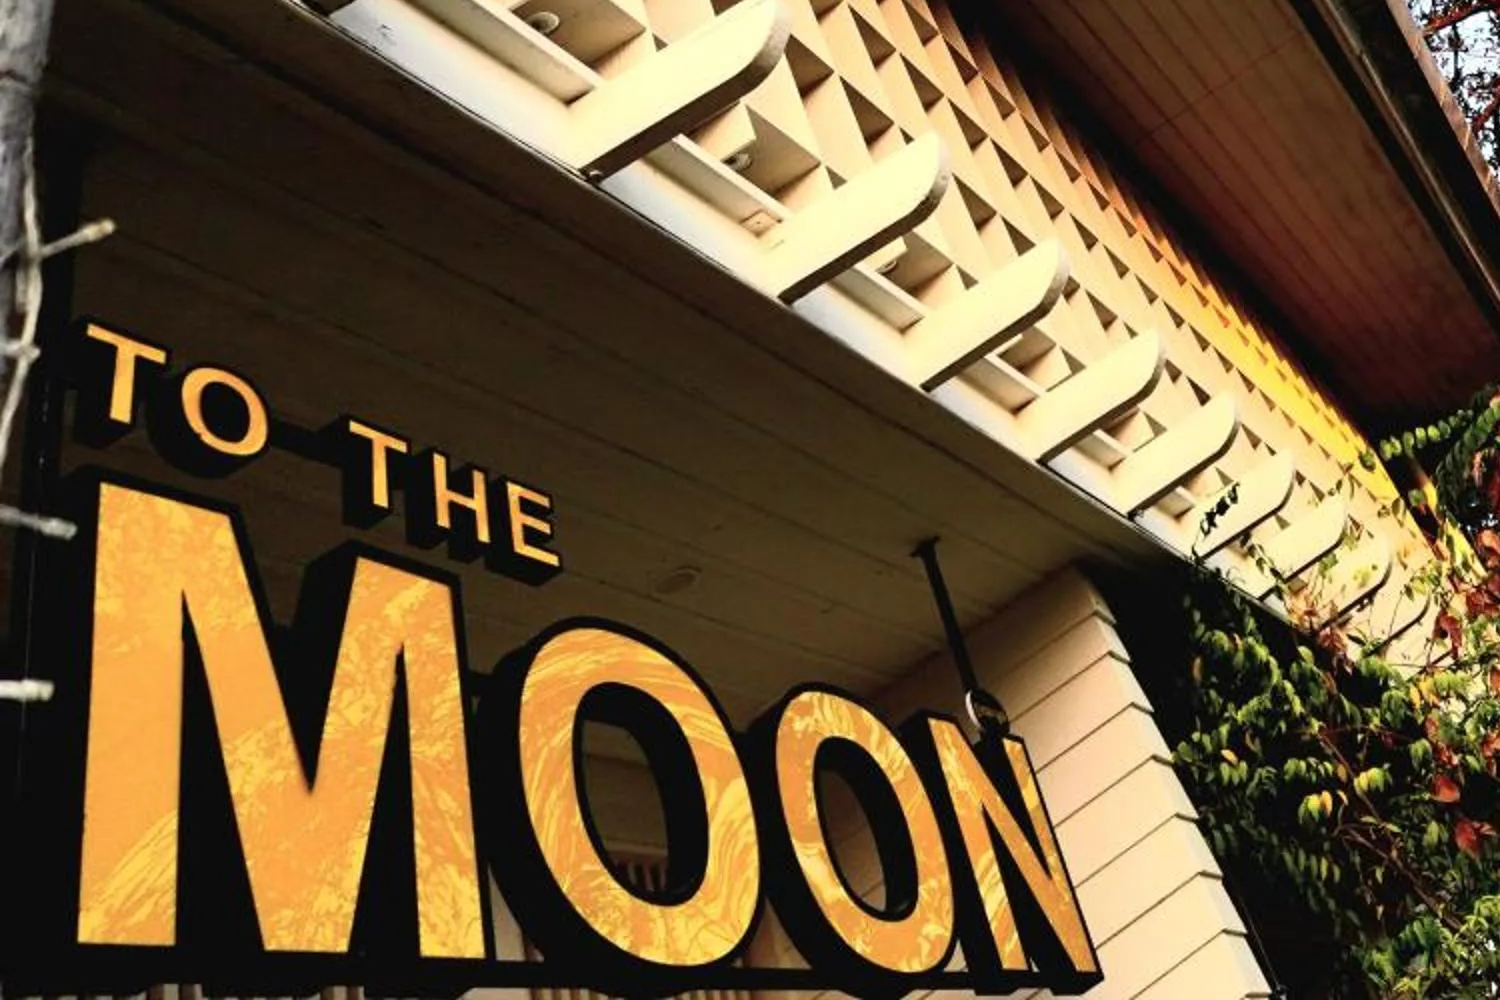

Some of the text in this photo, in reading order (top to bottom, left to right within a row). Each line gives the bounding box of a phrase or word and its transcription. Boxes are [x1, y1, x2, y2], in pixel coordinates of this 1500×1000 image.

[86, 323, 560, 566] TO THE
[77, 483, 1098, 974] MOON
